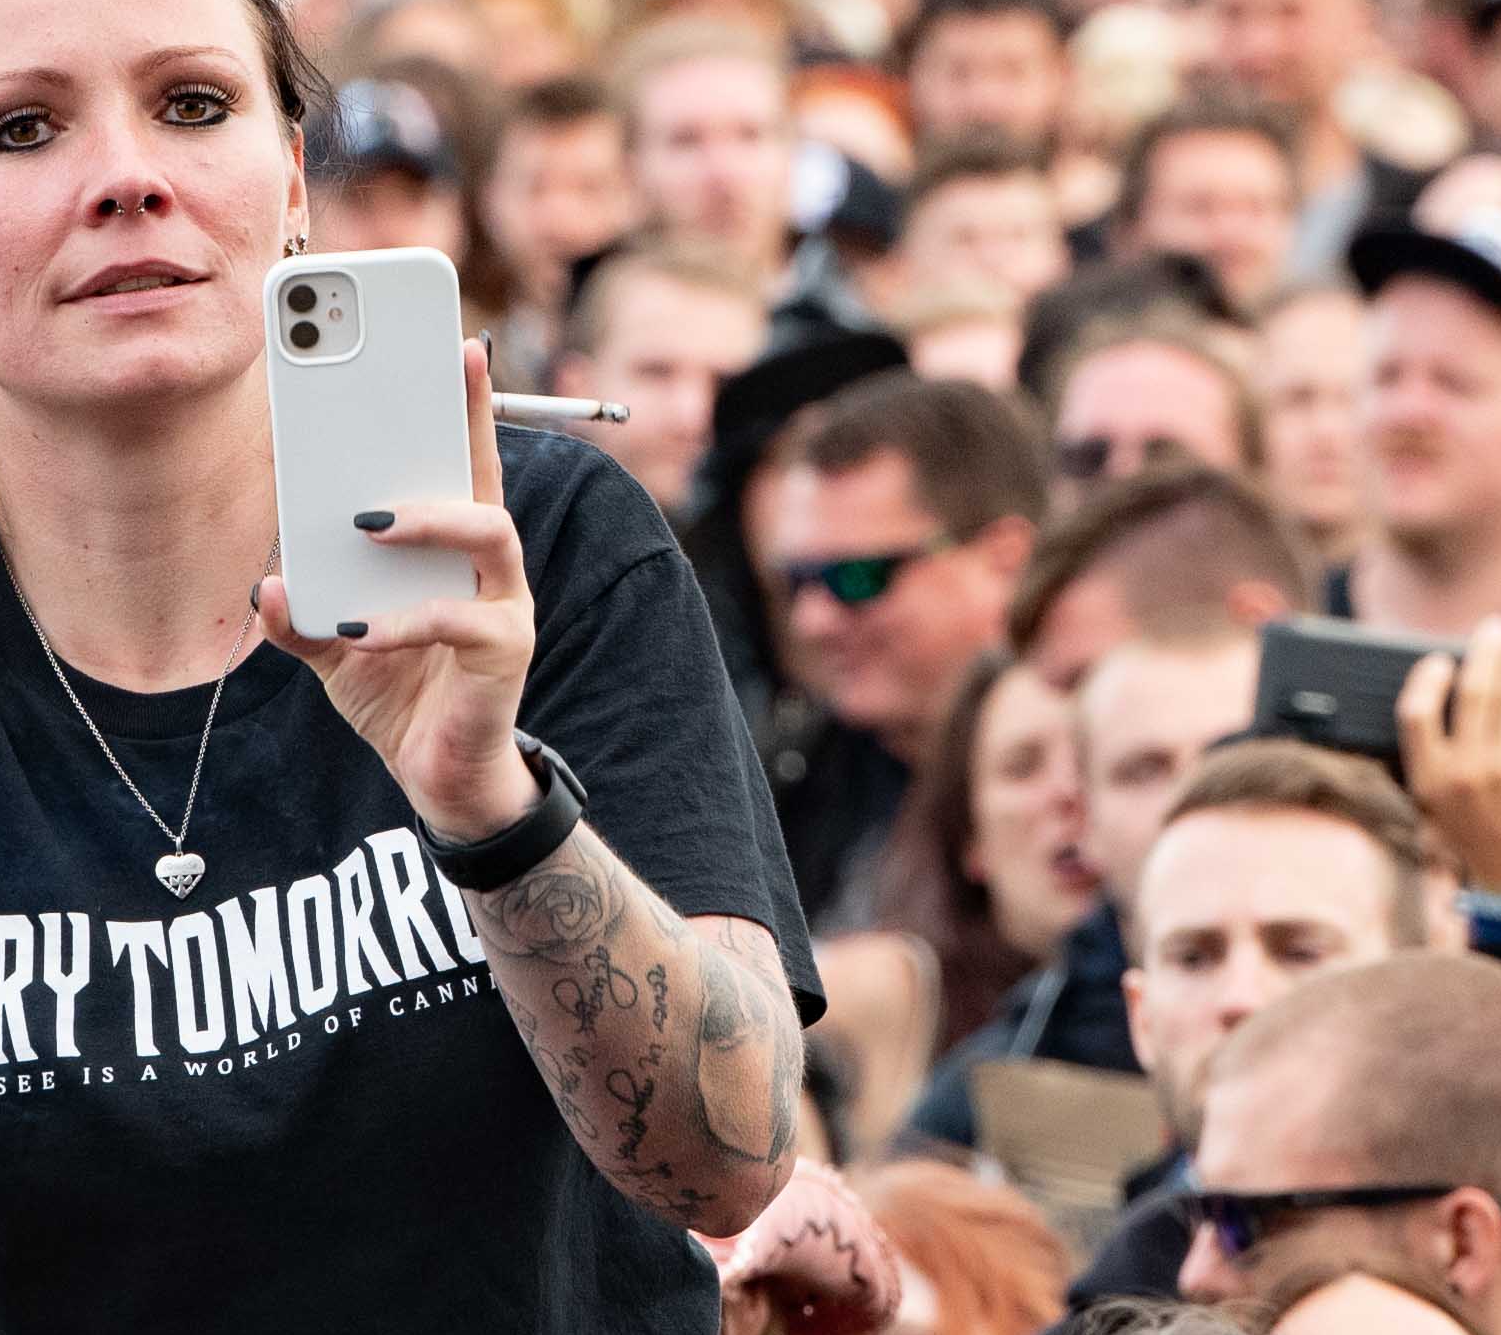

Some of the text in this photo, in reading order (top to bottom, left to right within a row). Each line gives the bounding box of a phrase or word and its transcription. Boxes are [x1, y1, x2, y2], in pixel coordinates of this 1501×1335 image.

[83, 1065, 115, 1085] IS
[140, 1063, 158, 1082] A
[183, 1031, 302, 1077] WORLD
[323, 1007, 363, 1036] OF
